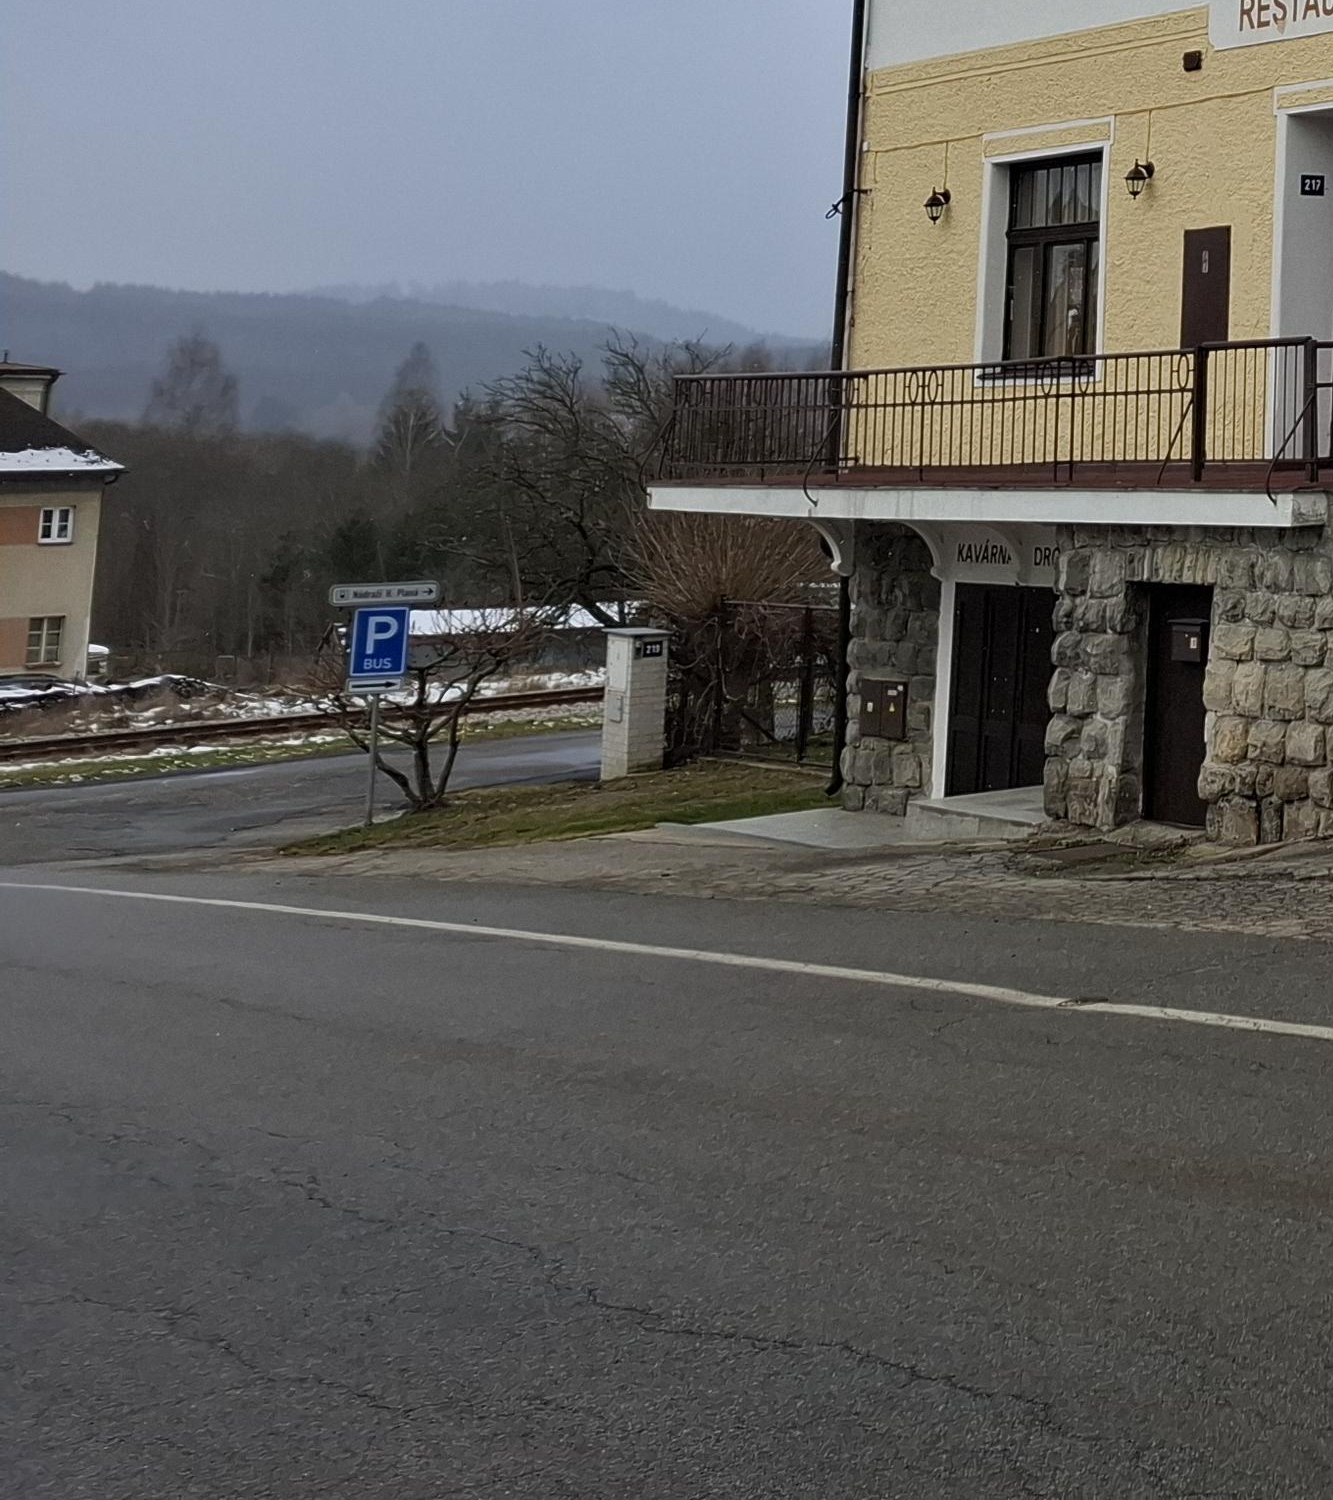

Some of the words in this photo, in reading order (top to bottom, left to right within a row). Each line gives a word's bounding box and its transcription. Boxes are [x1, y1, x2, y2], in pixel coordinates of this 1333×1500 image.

[1304, 178, 1321, 191] 217
[365, 615, 399, 655] P
[363, 657, 392, 670] BUS
